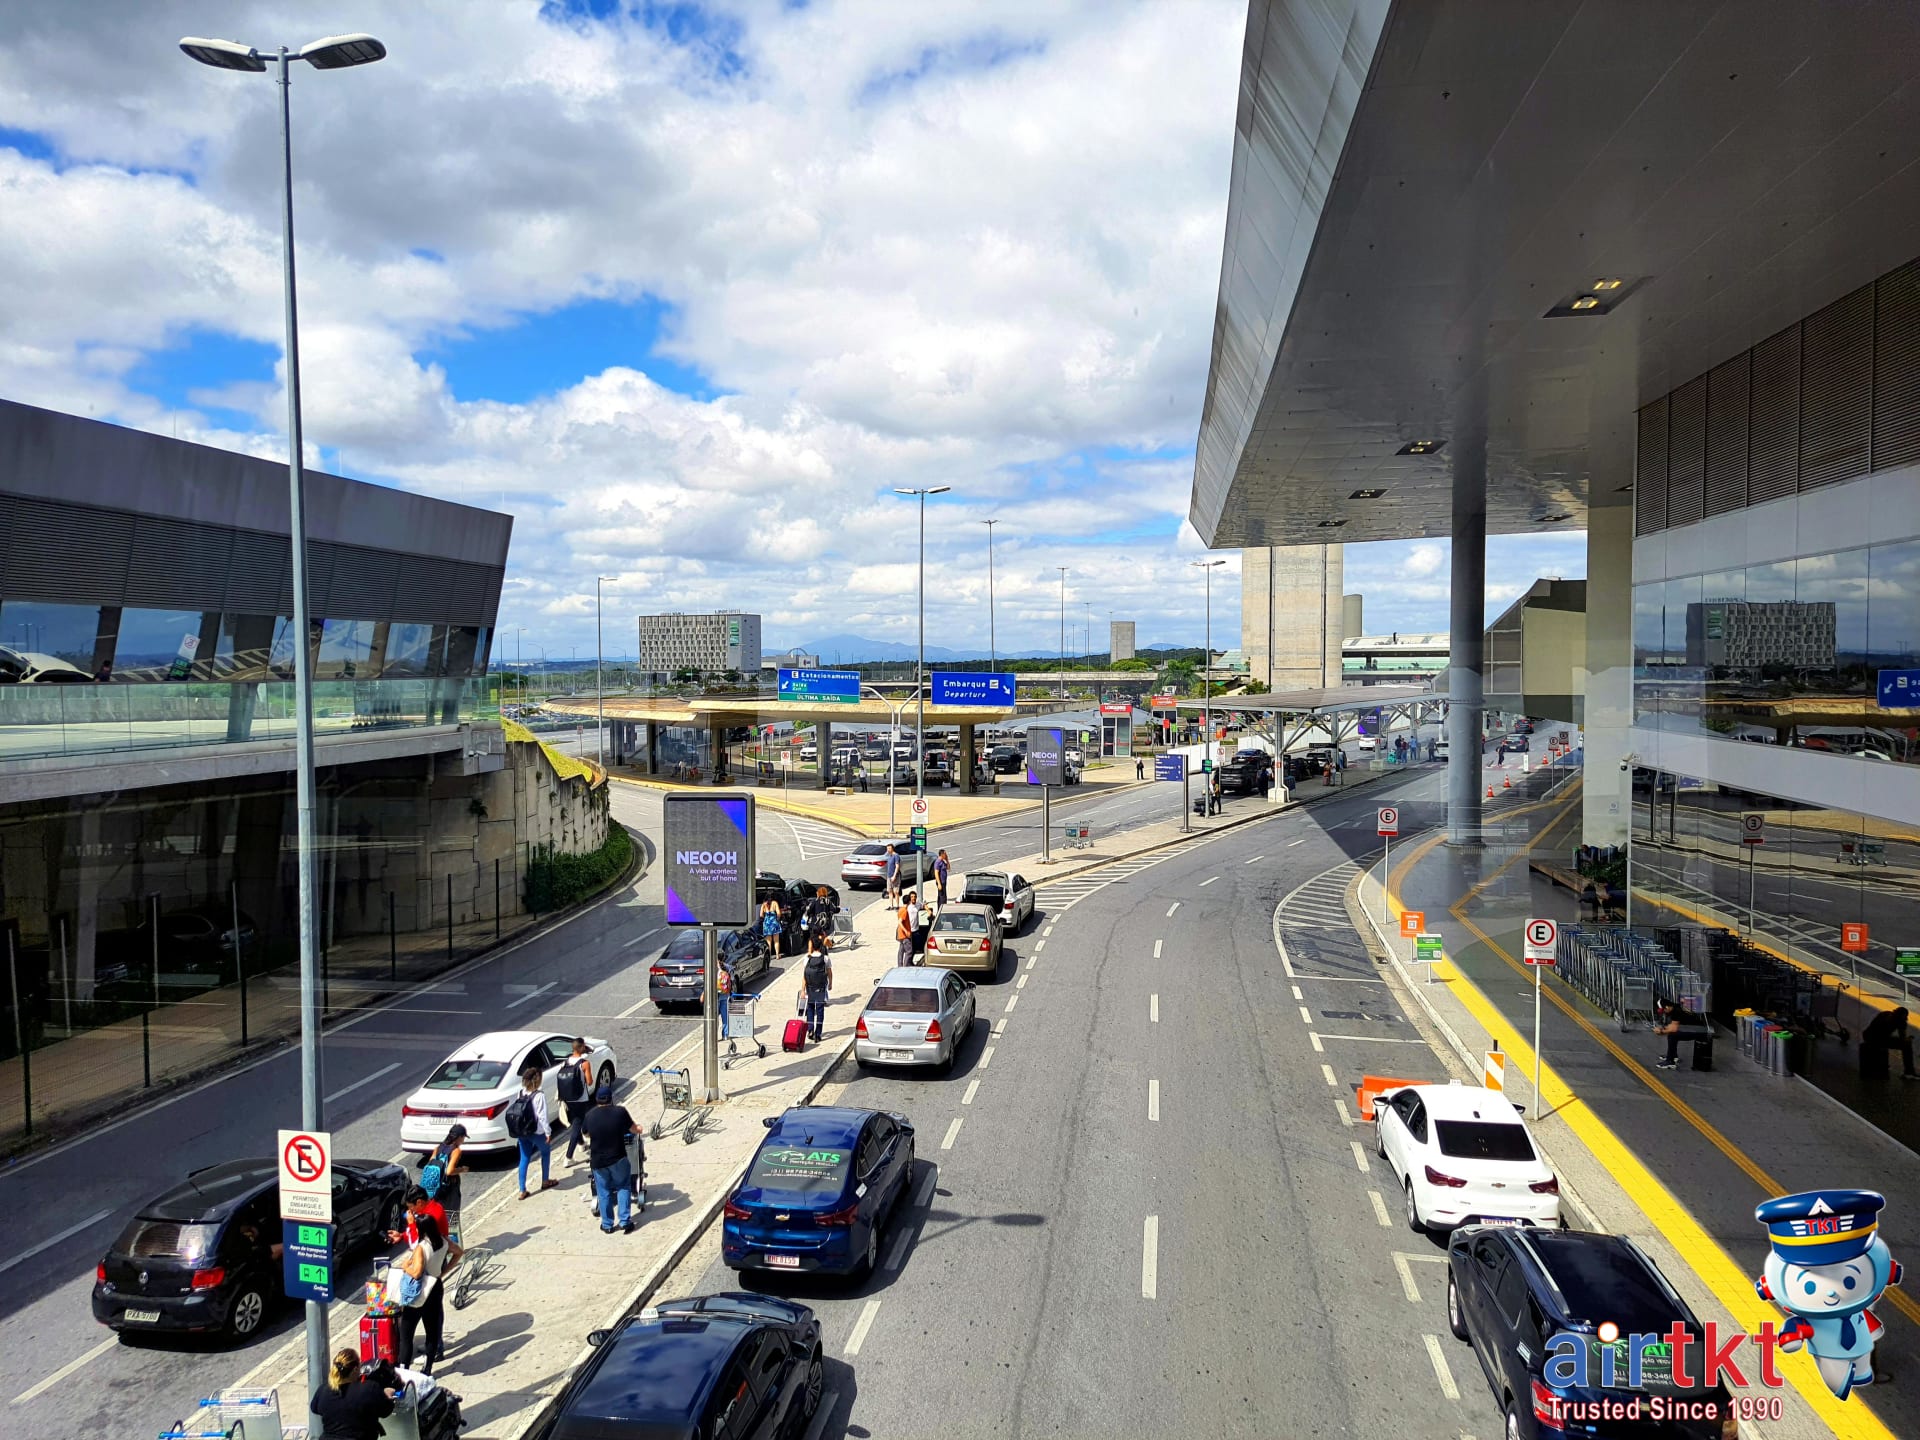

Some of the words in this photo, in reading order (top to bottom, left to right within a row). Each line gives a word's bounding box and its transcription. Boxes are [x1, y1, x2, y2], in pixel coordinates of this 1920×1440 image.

[801, 672, 859, 680] Estacionamentos
[943, 680, 986, 688] Embarque
[797, 692, 818, 700] ÚLTIMA
[944, 690, 986, 698] Departure
[1032, 751, 1058, 760] NEOOH
[1386, 812, 1392, 820] E
[676, 851, 737, 865] NEOOH
[1536, 926, 1546, 940] E
[298, 1144, 312, 1174] E
[807, 1152, 841, 1164] ATS
[290, 1201, 316, 1210] EMBARQUE
[288, 1208, 324, 1216] DESEMBARQUE
